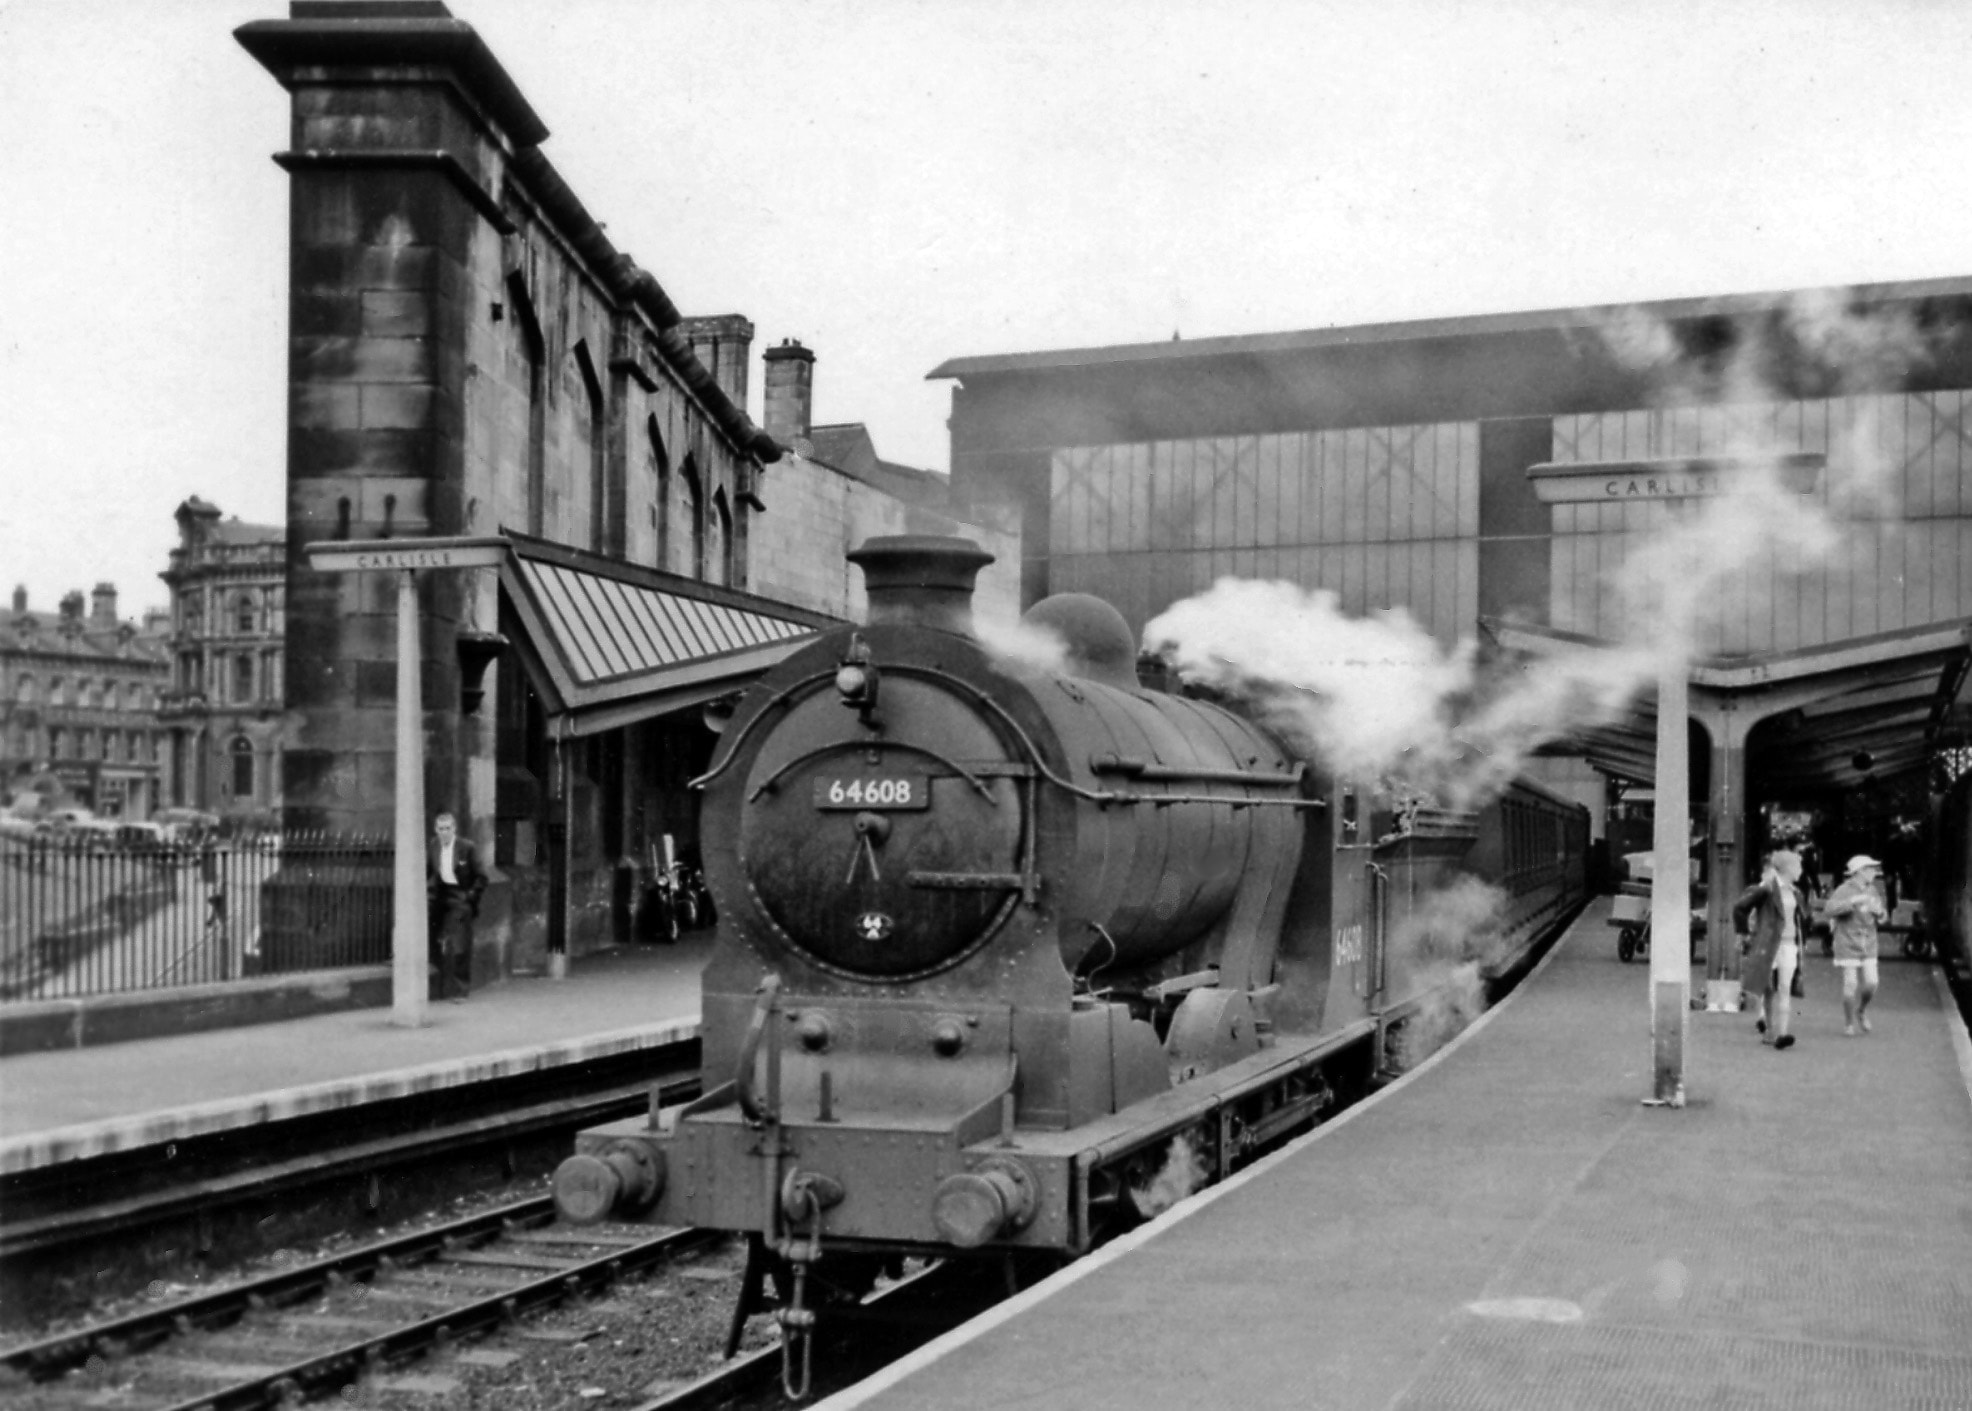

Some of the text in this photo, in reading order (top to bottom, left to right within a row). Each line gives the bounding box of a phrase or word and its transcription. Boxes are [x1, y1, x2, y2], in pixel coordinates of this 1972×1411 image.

[1604, 477, 1724, 496] CARLISL
[357, 552, 451, 569] CARLISLE
[830, 780, 911, 803] 64608
[863, 915, 882, 930] 64
